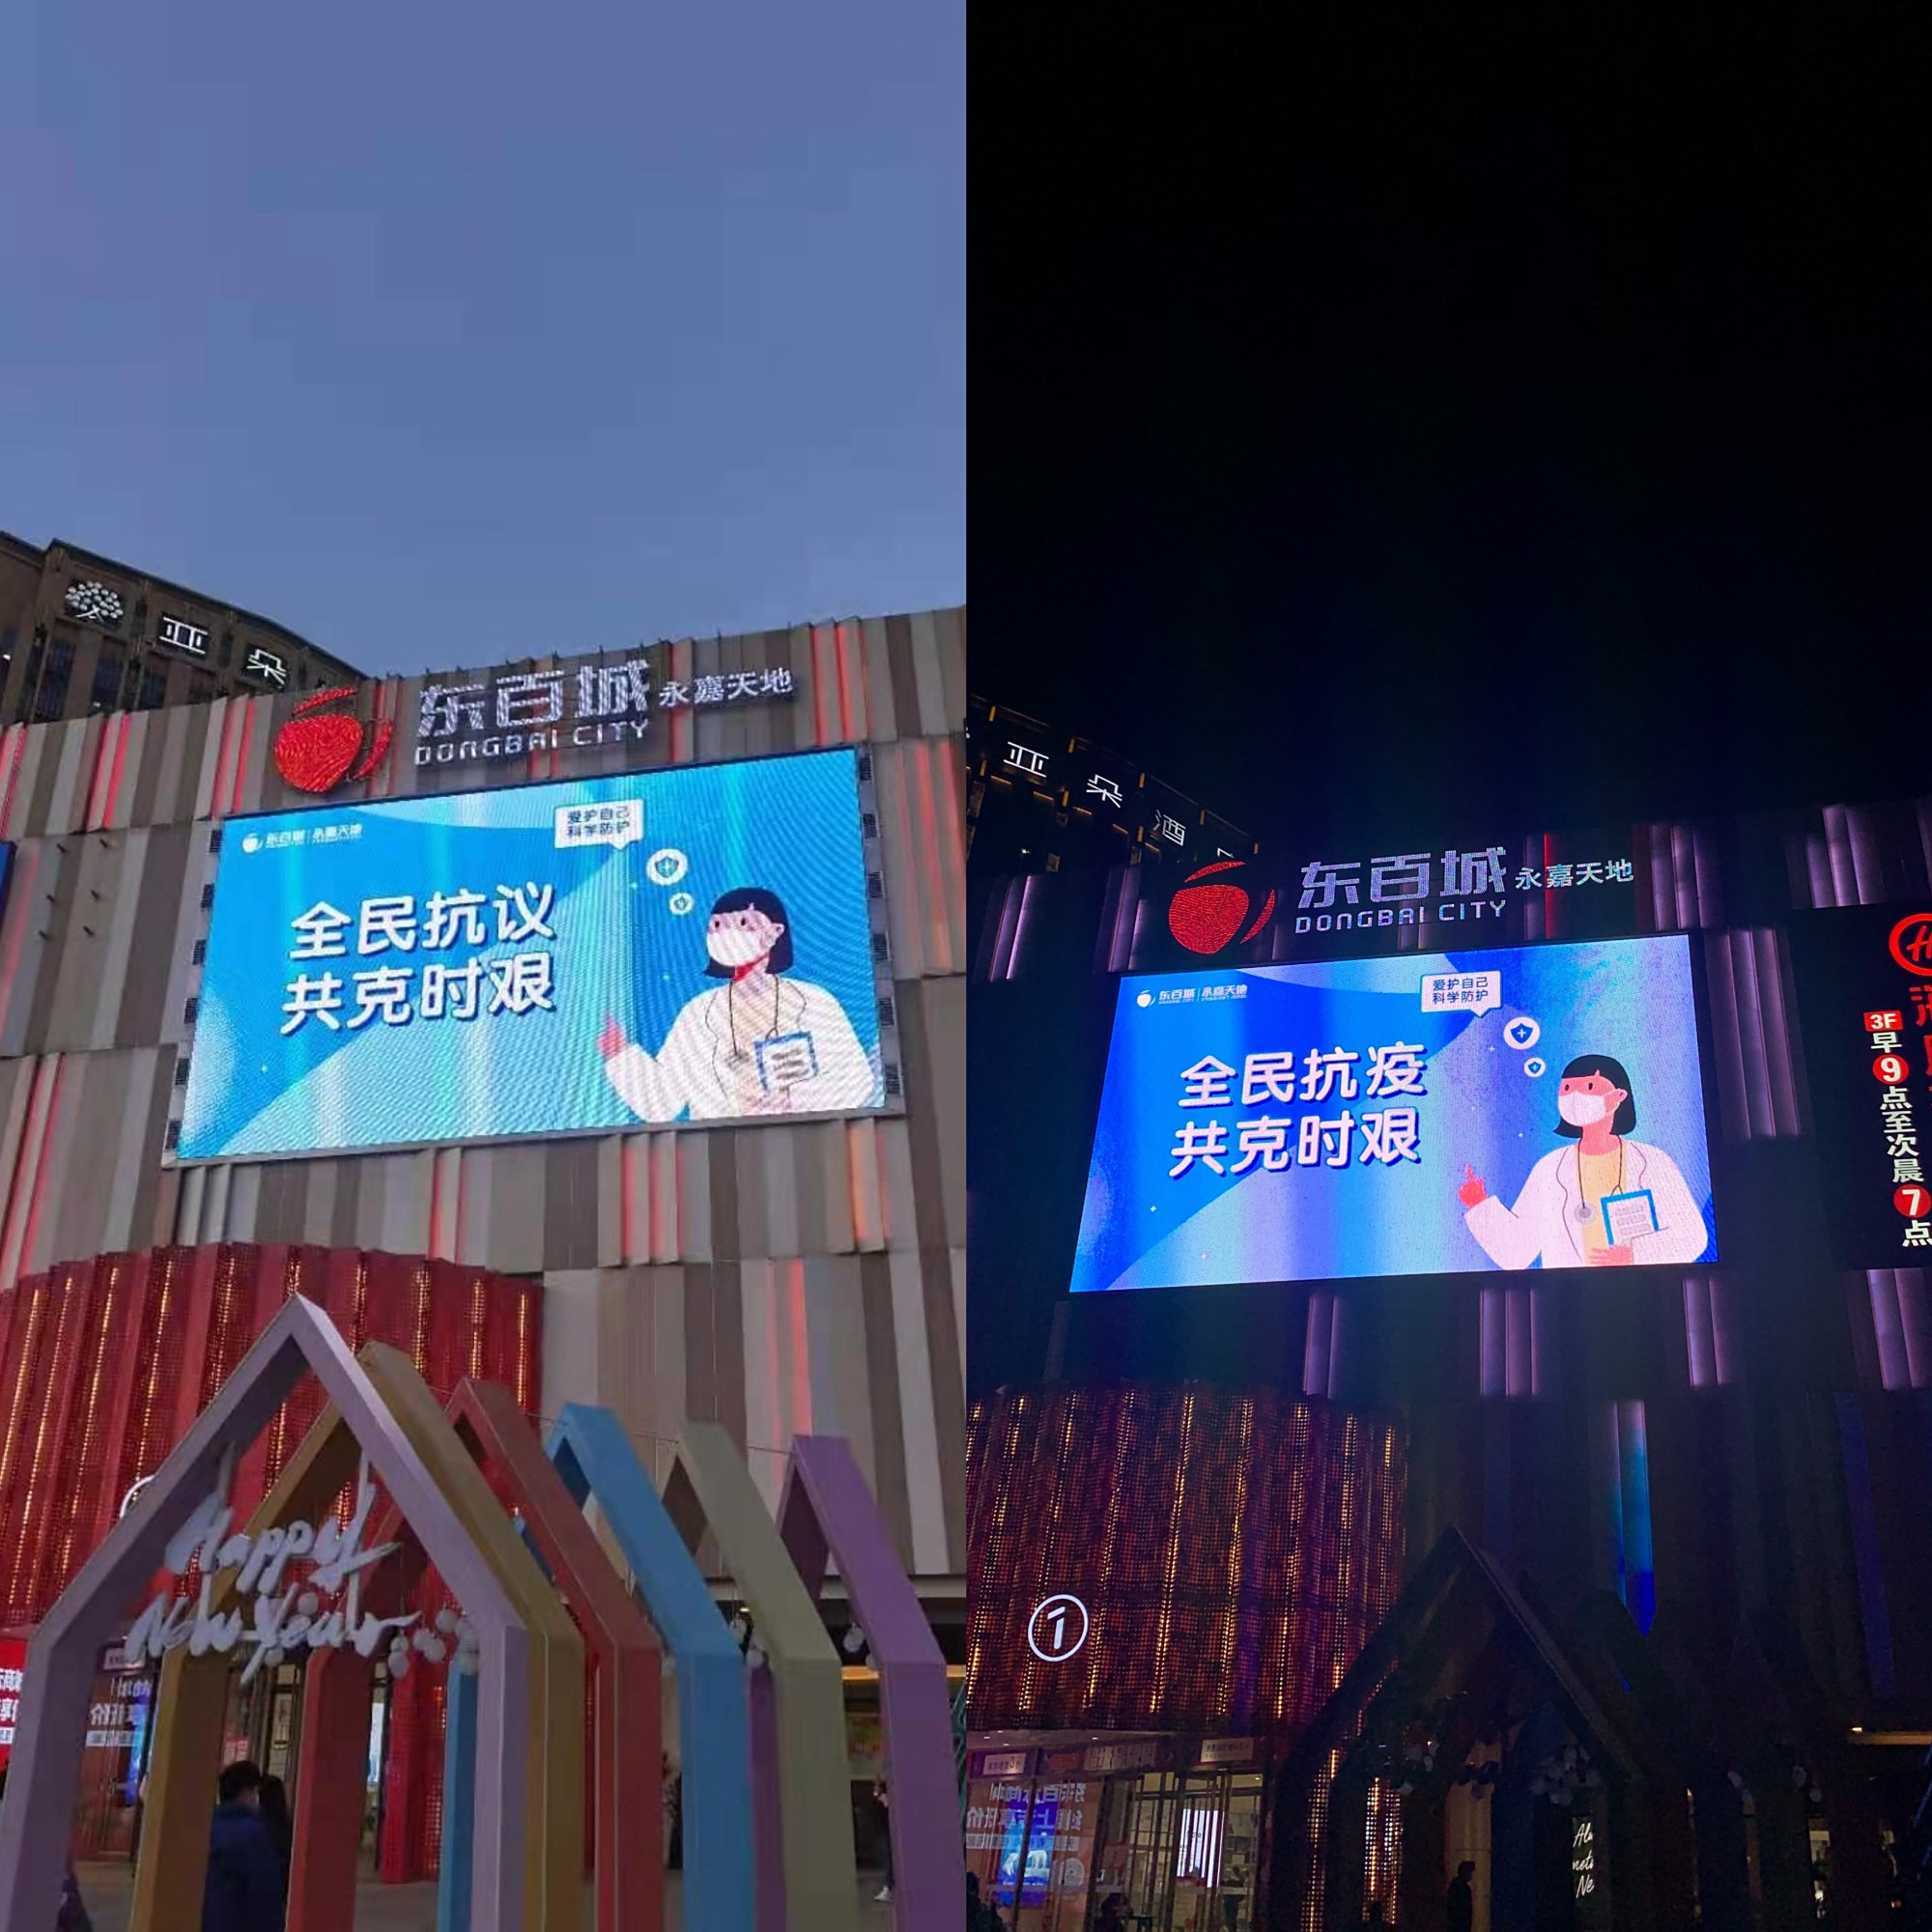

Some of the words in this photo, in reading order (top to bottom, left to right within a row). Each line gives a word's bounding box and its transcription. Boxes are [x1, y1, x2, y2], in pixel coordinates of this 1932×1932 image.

[418, 660, 650, 738] 东百城
[659, 668, 795, 707] 永嘉天地
[414, 729, 559, 767] DONGBAI
[574, 719, 650, 746] CITY
[1297, 846, 1506, 909] 东百城
[1515, 858, 1634, 891] 永嘉天地
[289, 880, 556, 961] 全民抗议
[1295, 906, 1425, 934] DONGBAI
[1438, 899, 1506, 922] CITY
[280, 952, 554, 1035] 共克时艰
[1433, 976, 1489, 992] 爱护自己
[1433, 989, 1489, 1005] 科学防护
[1869, 1013, 1897, 1030] 3F
[1178, 1040, 1428, 1109] 全民抗疫
[1168, 1106, 1421, 1179] 共克时艰
